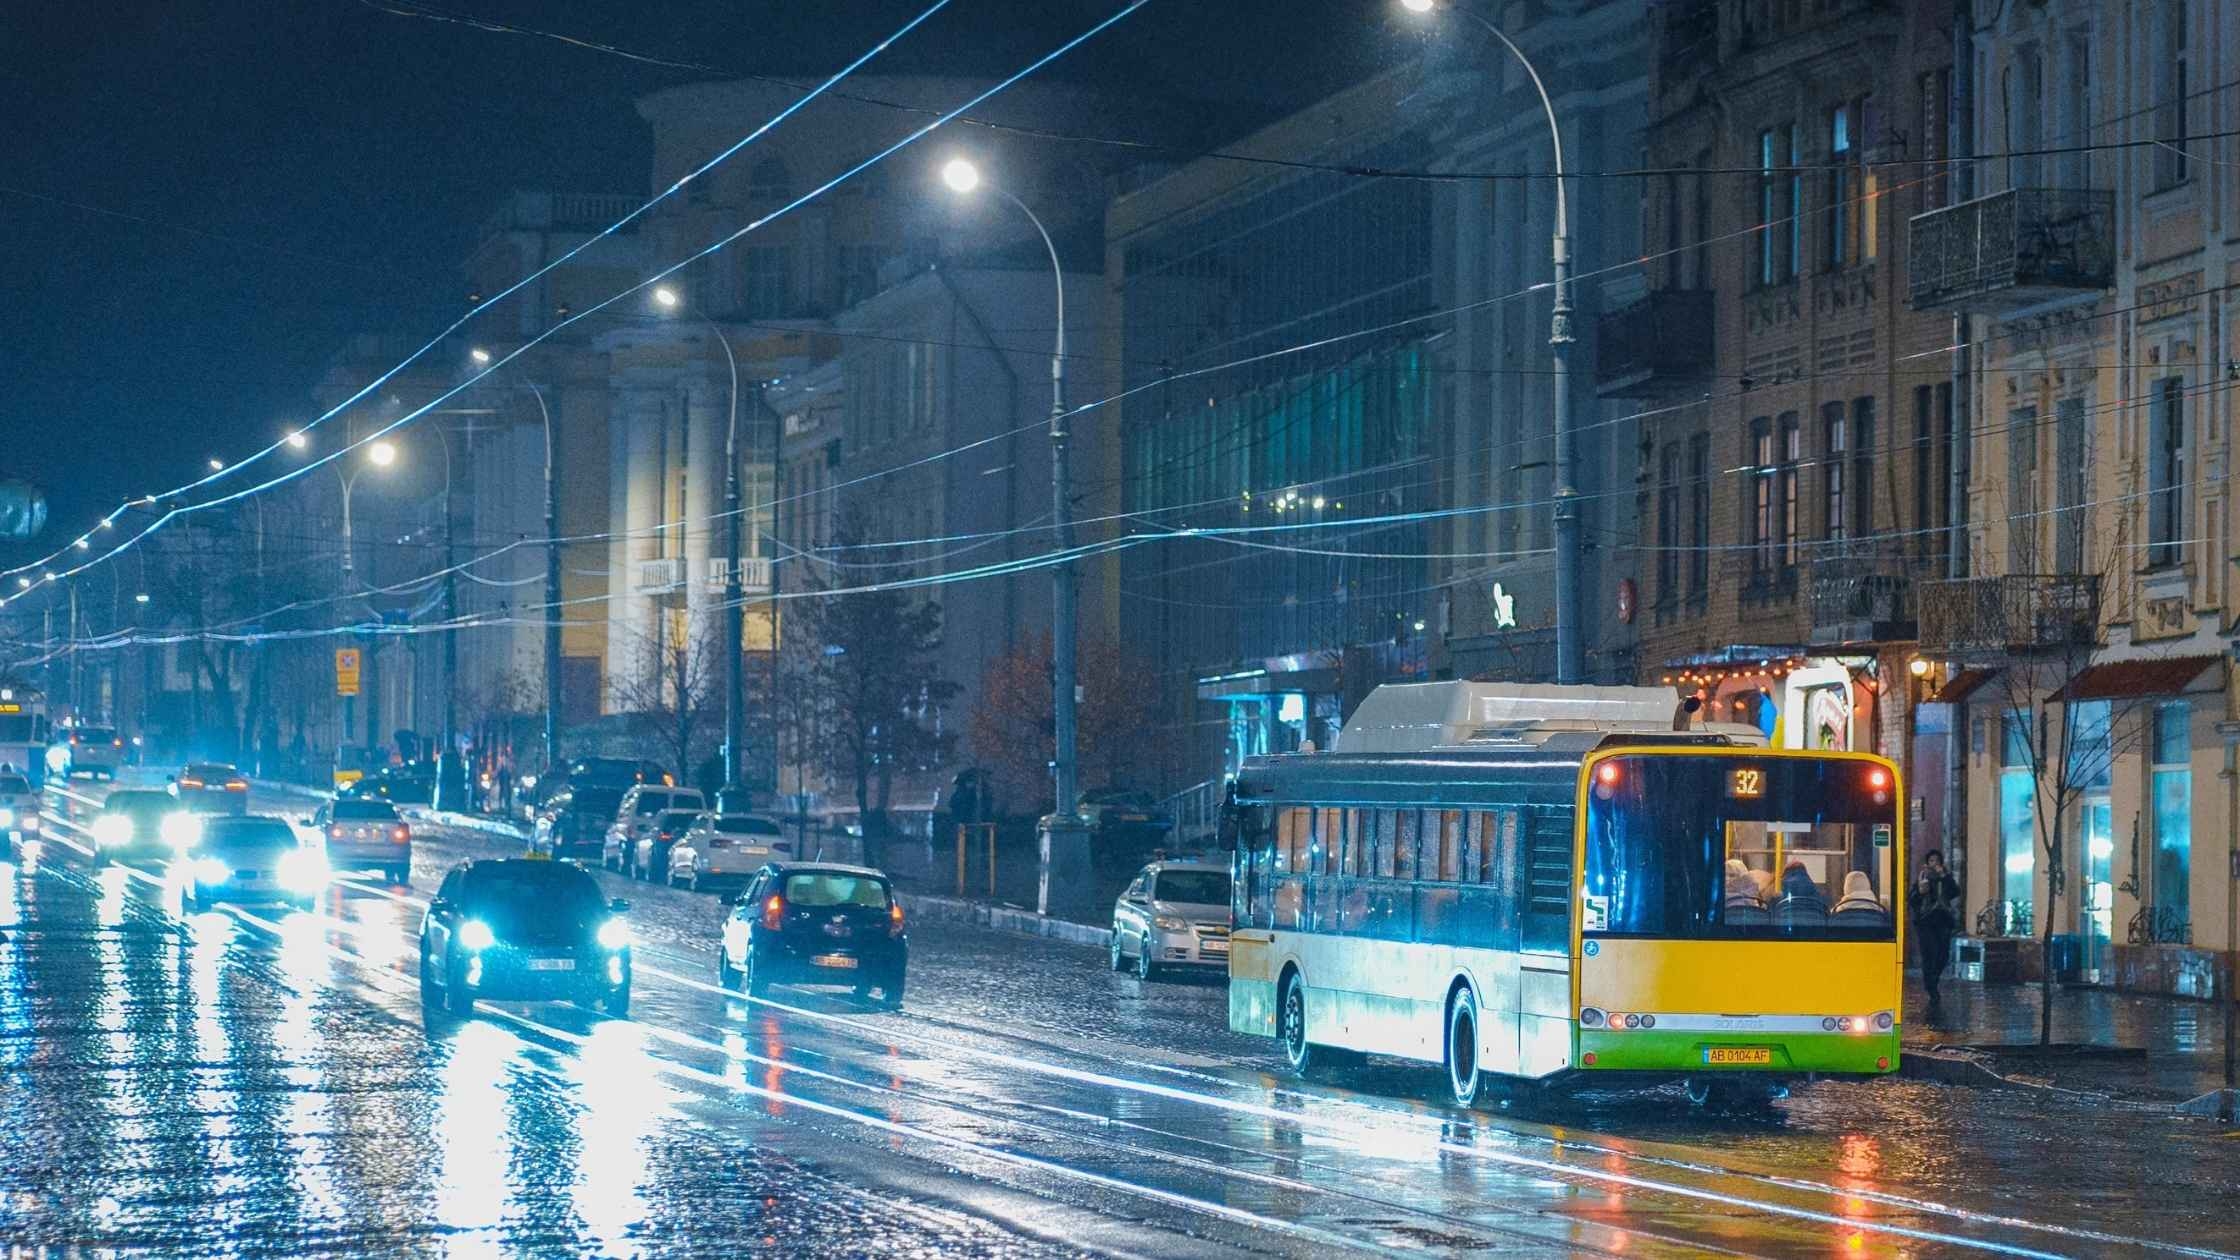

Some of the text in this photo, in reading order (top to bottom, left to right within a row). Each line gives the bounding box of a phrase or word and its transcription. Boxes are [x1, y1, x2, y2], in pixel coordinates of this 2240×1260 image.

[1736, 769, 1758, 794] 32
[1711, 1050, 1767, 1061] AB 0104 AF
